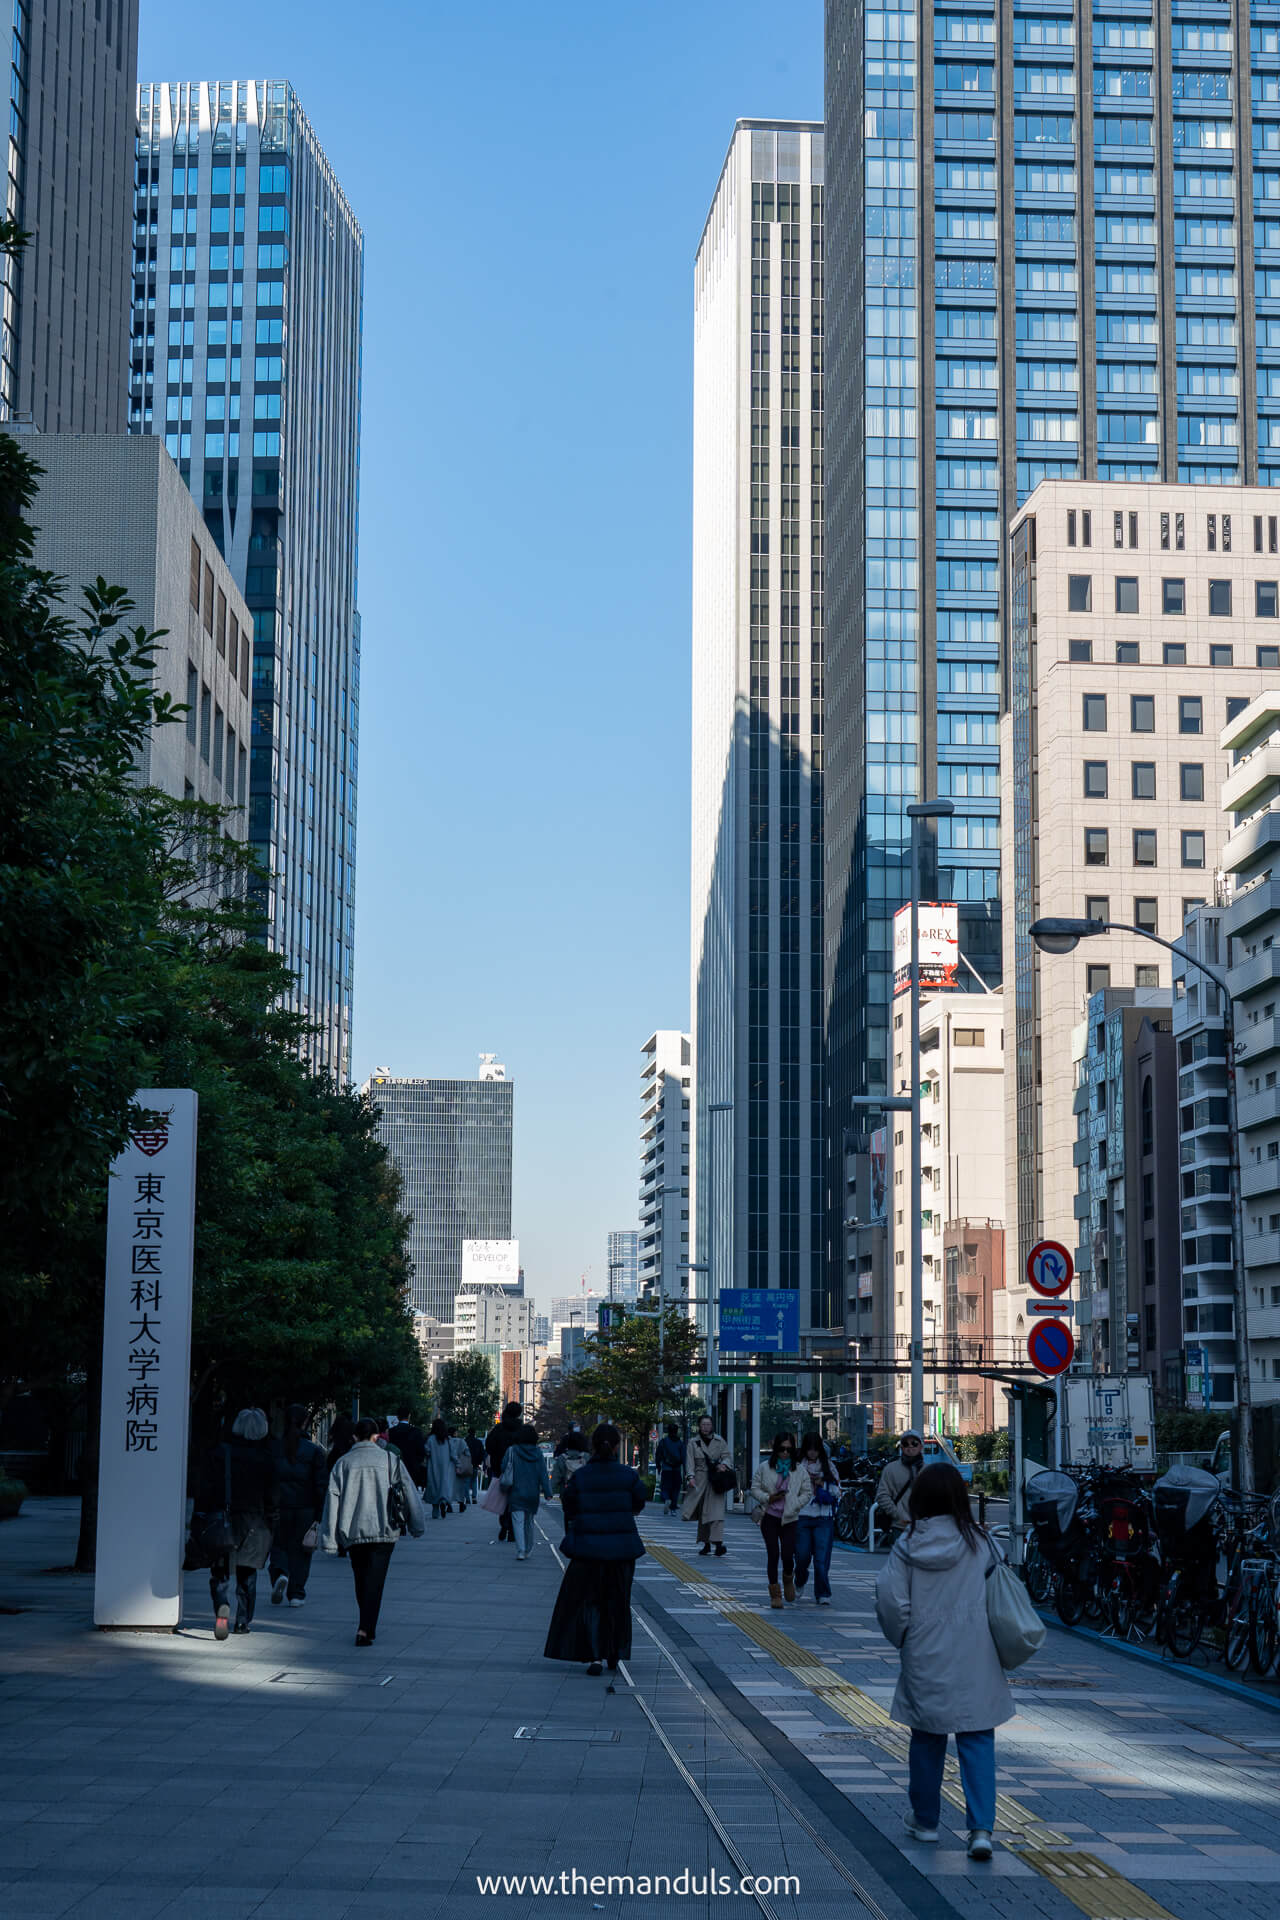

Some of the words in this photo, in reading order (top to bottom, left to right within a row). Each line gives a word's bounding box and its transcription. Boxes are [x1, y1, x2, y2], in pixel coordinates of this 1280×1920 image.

[125, 1172, 166, 1453] 東京医科大学病院
[472, 1253, 508, 1262] DEVELOP
